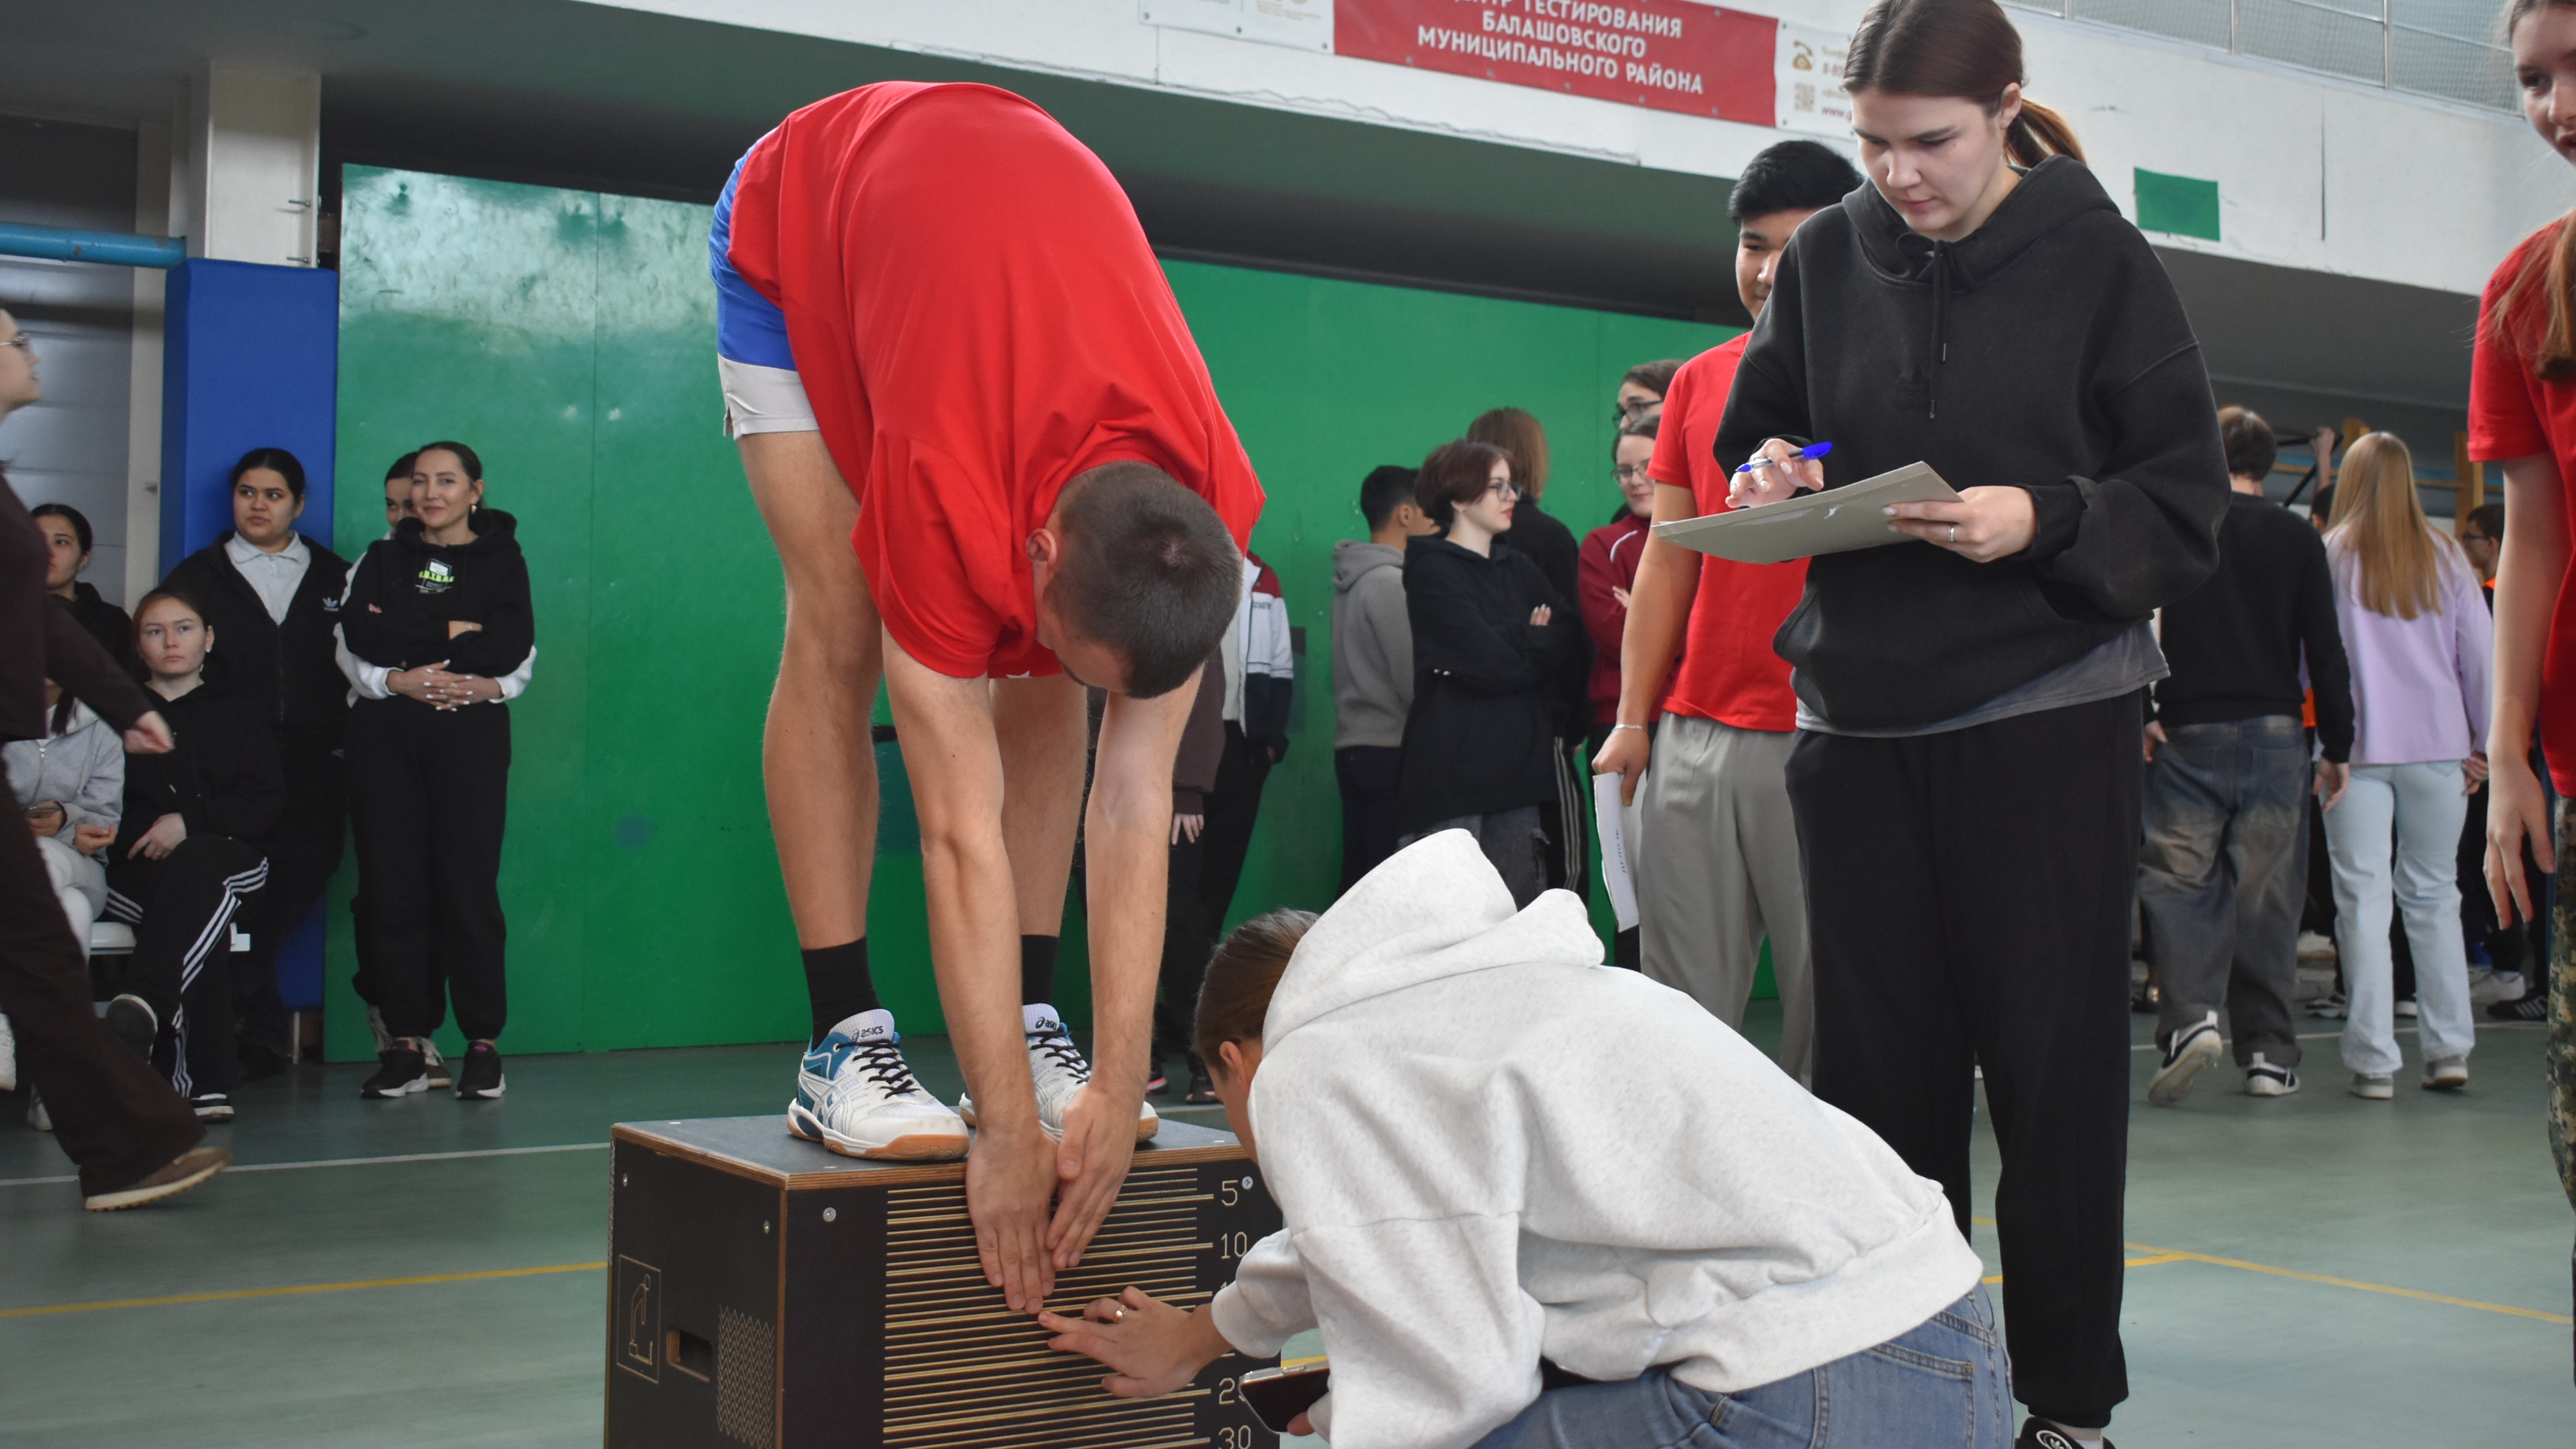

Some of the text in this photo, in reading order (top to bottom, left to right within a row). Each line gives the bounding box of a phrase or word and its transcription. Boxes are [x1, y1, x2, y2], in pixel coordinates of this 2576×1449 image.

[1482, 10, 1646, 58] БАЛАШОВСКОГО
[1418, 25, 1703, 95] МУНИЦИПАЛЬНОГО РАЙОНА
[861, 1025, 883, 1038] asics
[1222, 1180, 1238, 1206] 5
[1221, 1231, 1247, 1259] 10
[1218, 1425, 1251, 1449] 30
